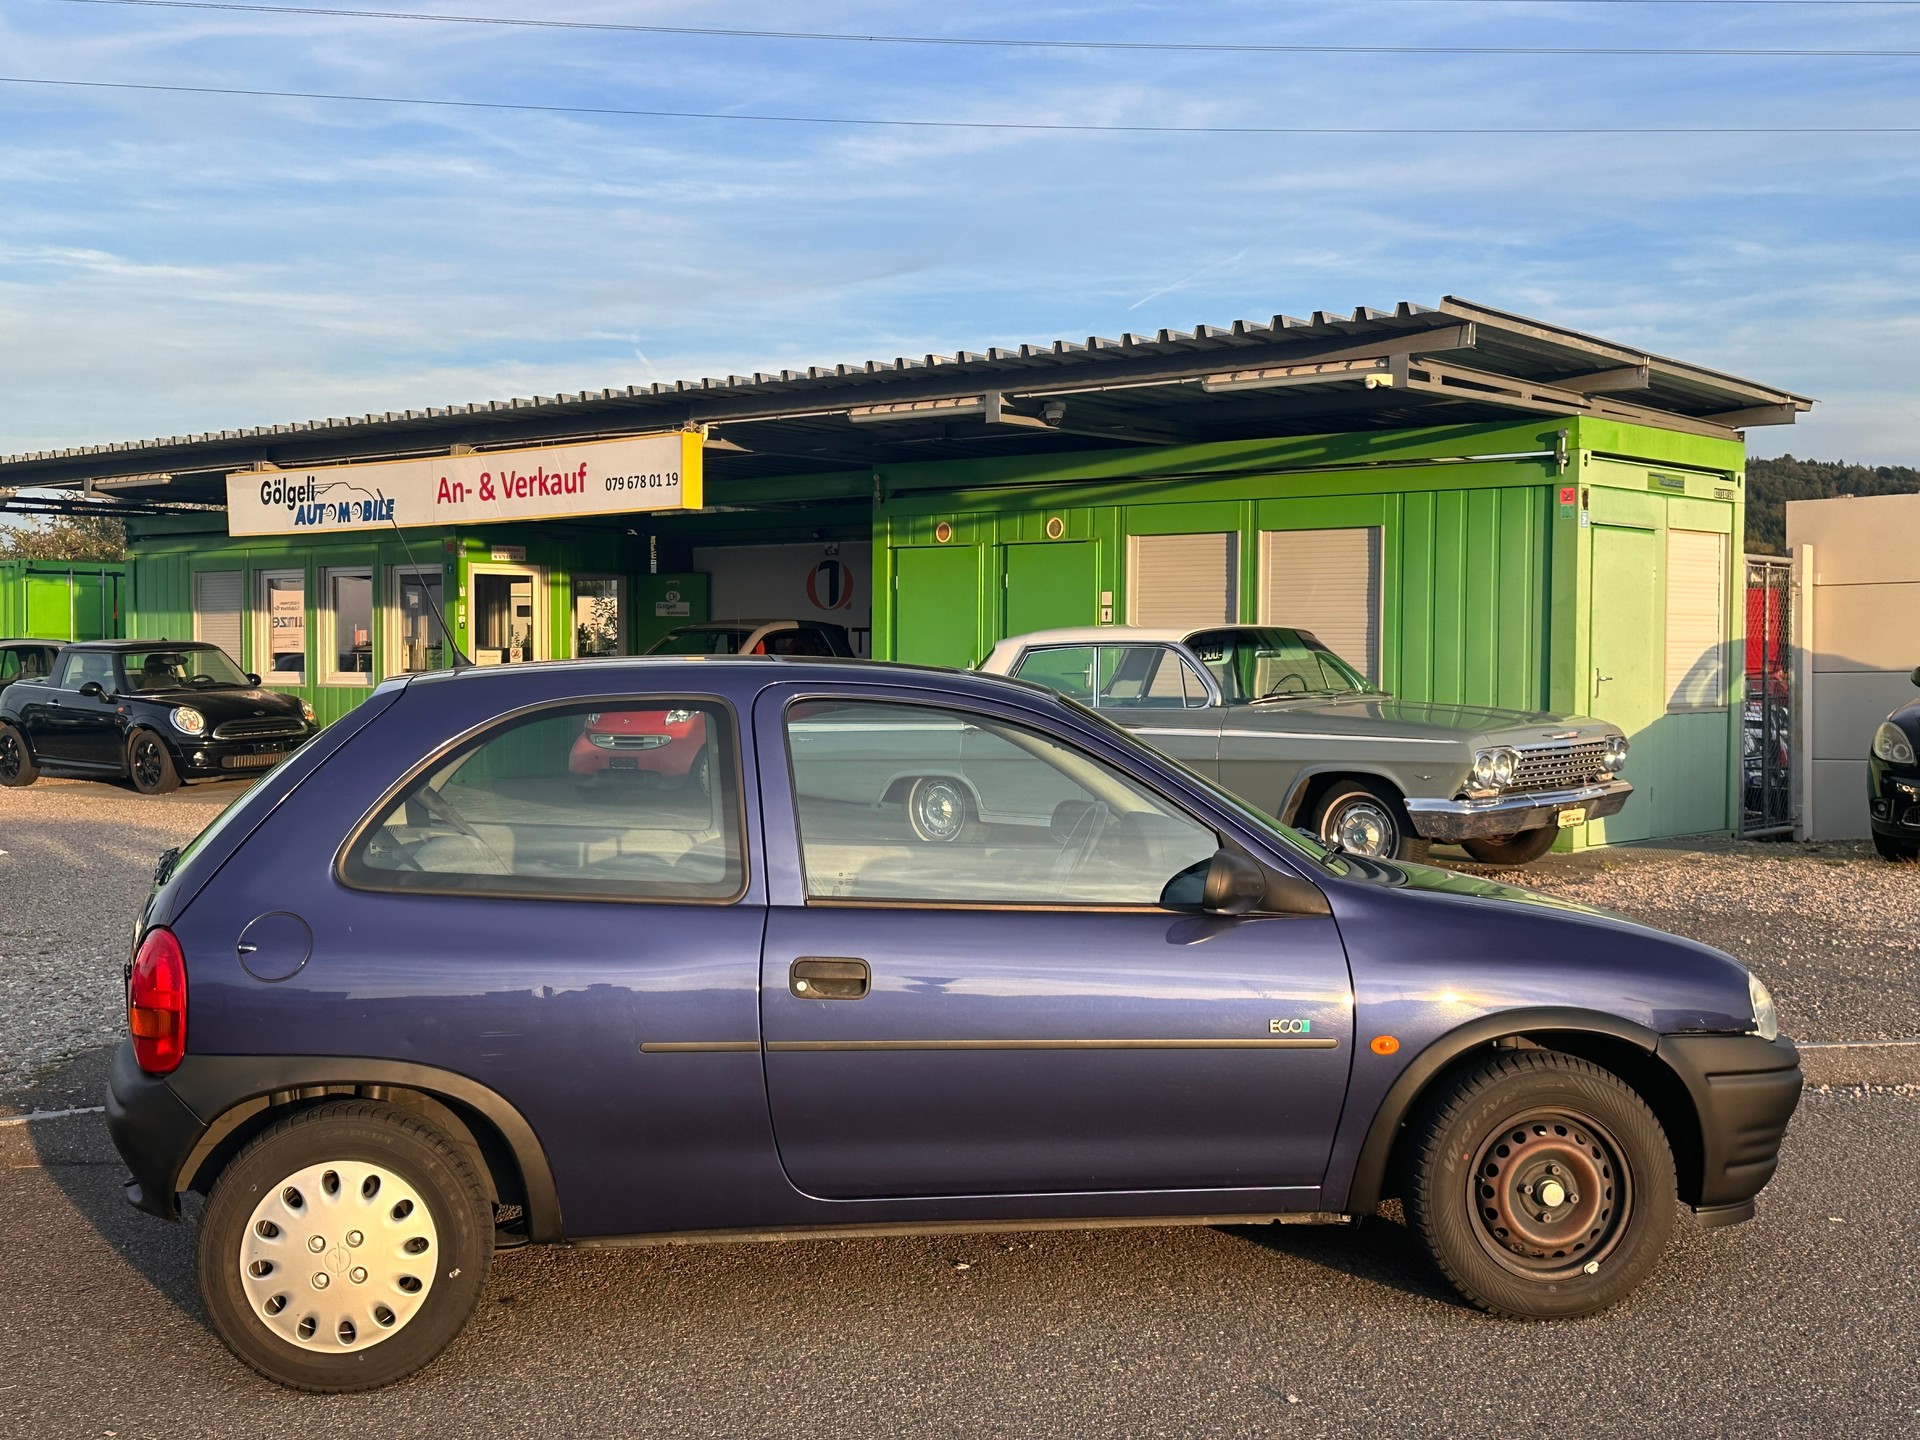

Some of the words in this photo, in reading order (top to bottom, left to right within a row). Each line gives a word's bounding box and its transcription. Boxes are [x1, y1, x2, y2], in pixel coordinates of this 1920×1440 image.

[260, 475, 315, 511] Gölgeli
[437, 477, 472, 504] An-
[479, 472, 496, 502] &
[500, 462, 587, 499] Verkauf
[605, 477, 624, 491] 079
[627, 475, 647, 490] 678
[649, 473, 662, 487] 01
[665, 472, 679, 486] 19
[1269, 1018, 1304, 1034] ECO
